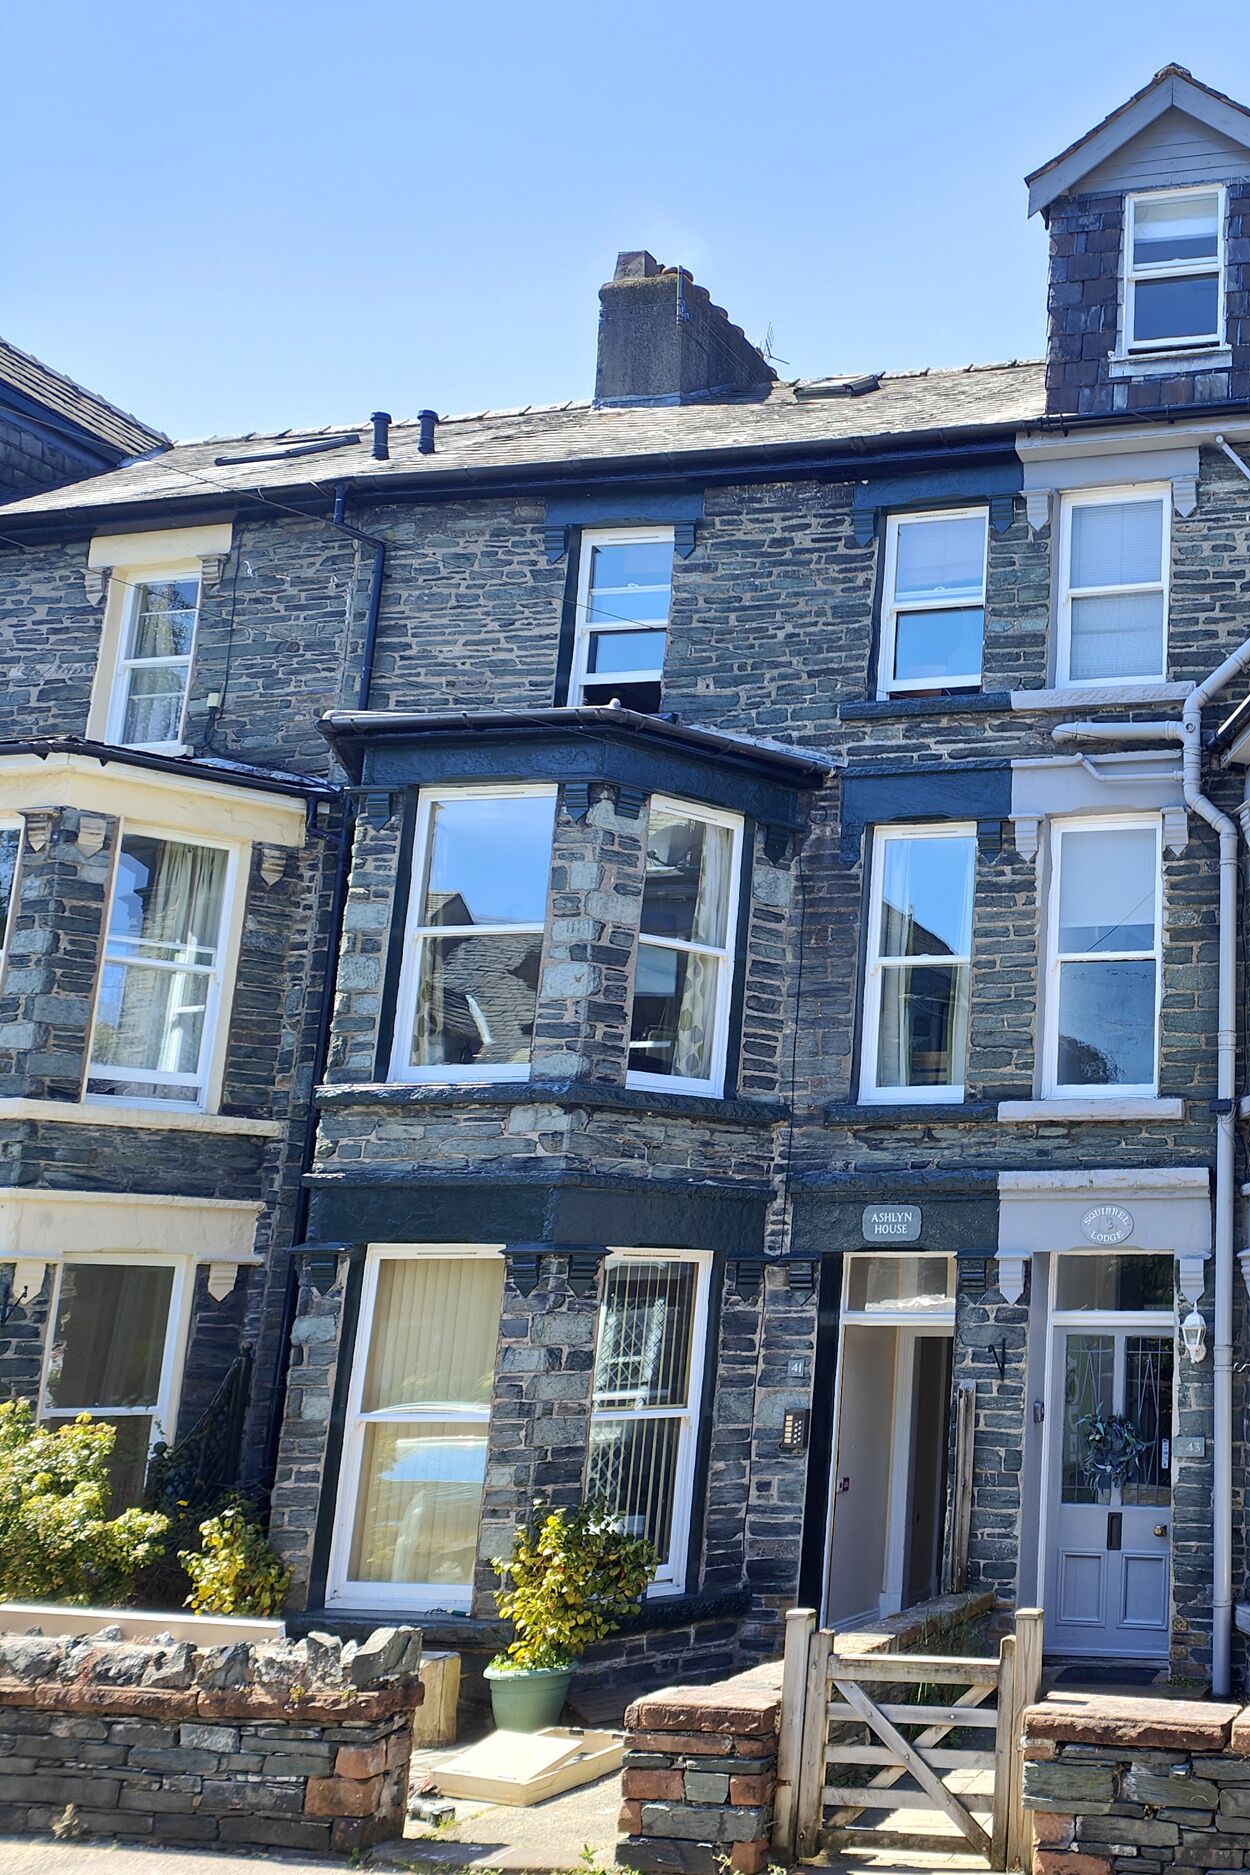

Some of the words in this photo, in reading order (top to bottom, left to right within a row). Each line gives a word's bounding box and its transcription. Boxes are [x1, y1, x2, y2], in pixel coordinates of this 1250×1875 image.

[871, 1212, 912, 1222] ASHLYN
[1083, 1207, 1129, 1226] SQUIRREL
[874, 1224, 908, 1234] HOUSE
[1090, 1230, 1124, 1242] LODGE
[791, 1362, 802, 1373] 41
[1185, 1442, 1201, 1453] 43
